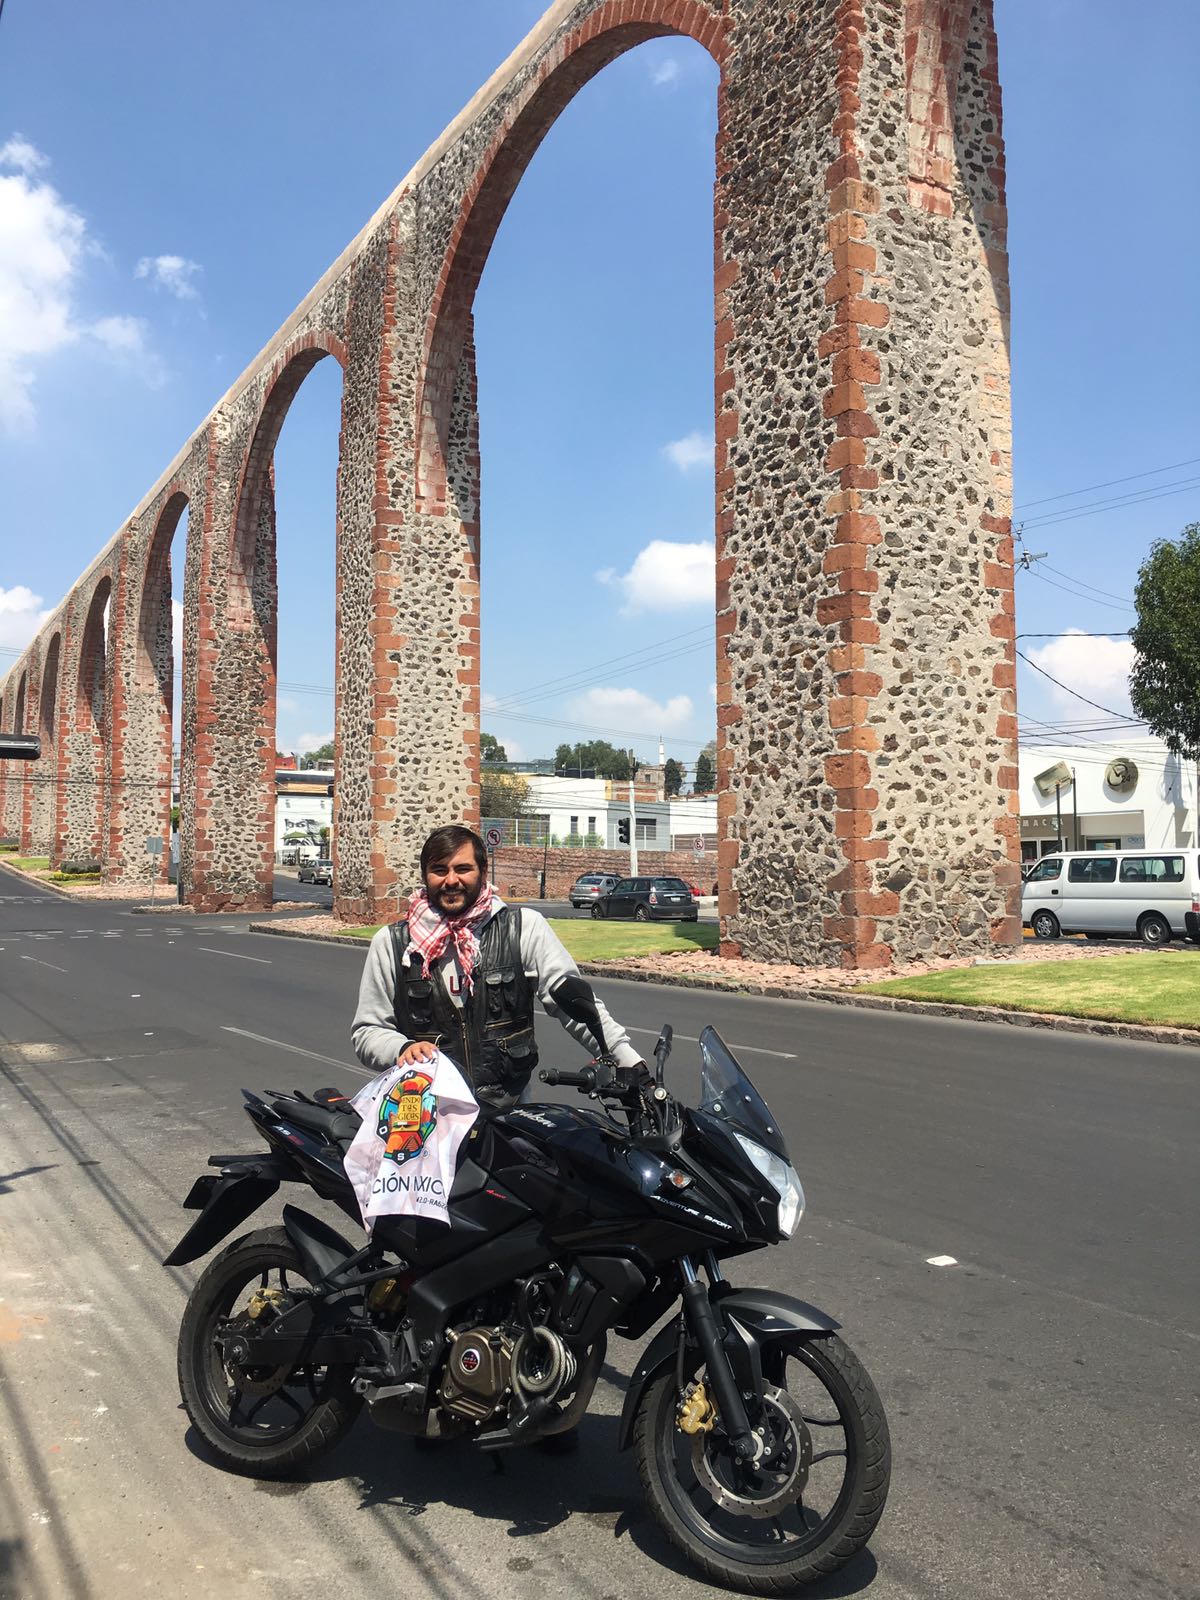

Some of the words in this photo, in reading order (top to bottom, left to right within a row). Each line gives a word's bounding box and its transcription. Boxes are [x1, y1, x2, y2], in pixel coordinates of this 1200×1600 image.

[1022, 818, 1064, 827] MACA
[404, 1071, 414, 1079] N
[397, 1152, 405, 1161] S
